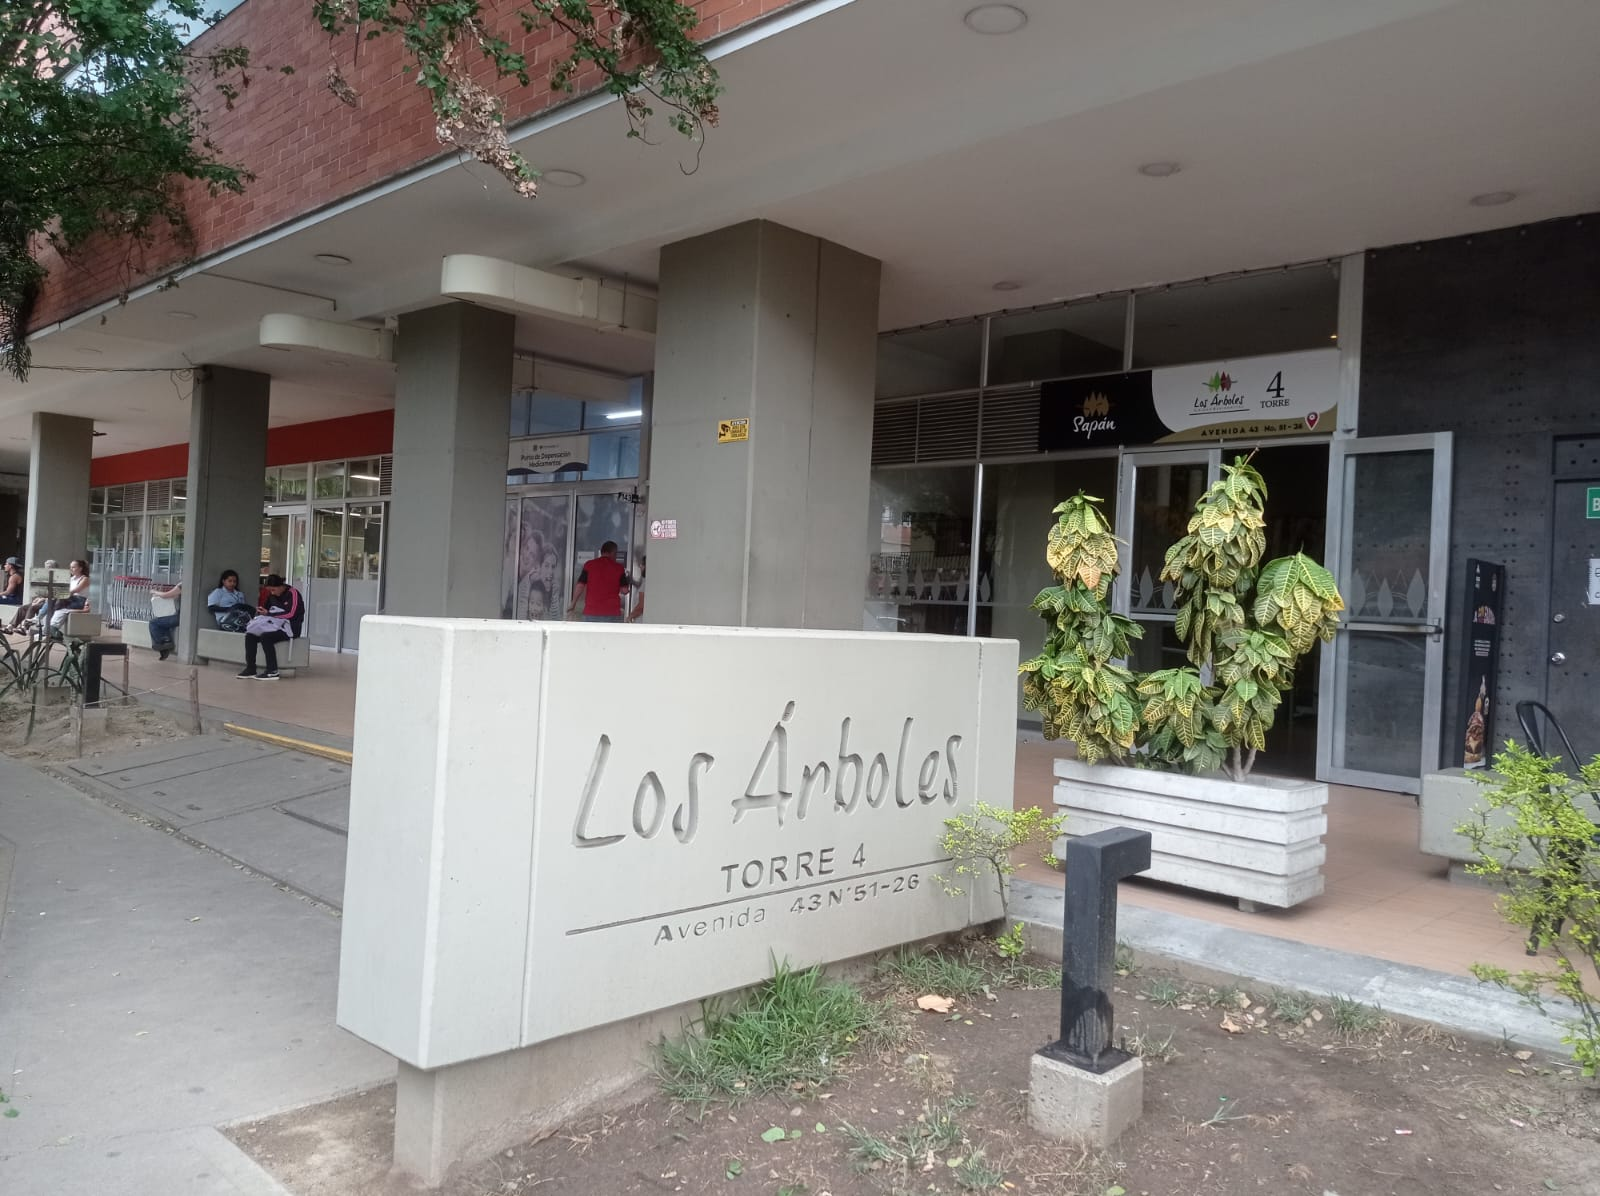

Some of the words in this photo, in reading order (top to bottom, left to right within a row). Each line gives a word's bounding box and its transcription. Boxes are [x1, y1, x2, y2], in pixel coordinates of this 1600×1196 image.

[1265, 370, 1285, 398] 4
[1194, 397, 1208, 408] Los
[1210, 393, 1244, 406] Árboles
[1260, 398, 1290, 408] TORRE
[1073, 415, 1116, 440] Sapán
[1201, 427, 1246, 436] AVENIDA
[572, 733, 715, 848] Los
[731, 700, 962, 828] Árboles
[721, 847, 835, 893] TORRE
[852, 843, 867, 868] 4
[653, 906, 766, 946] Avenida
